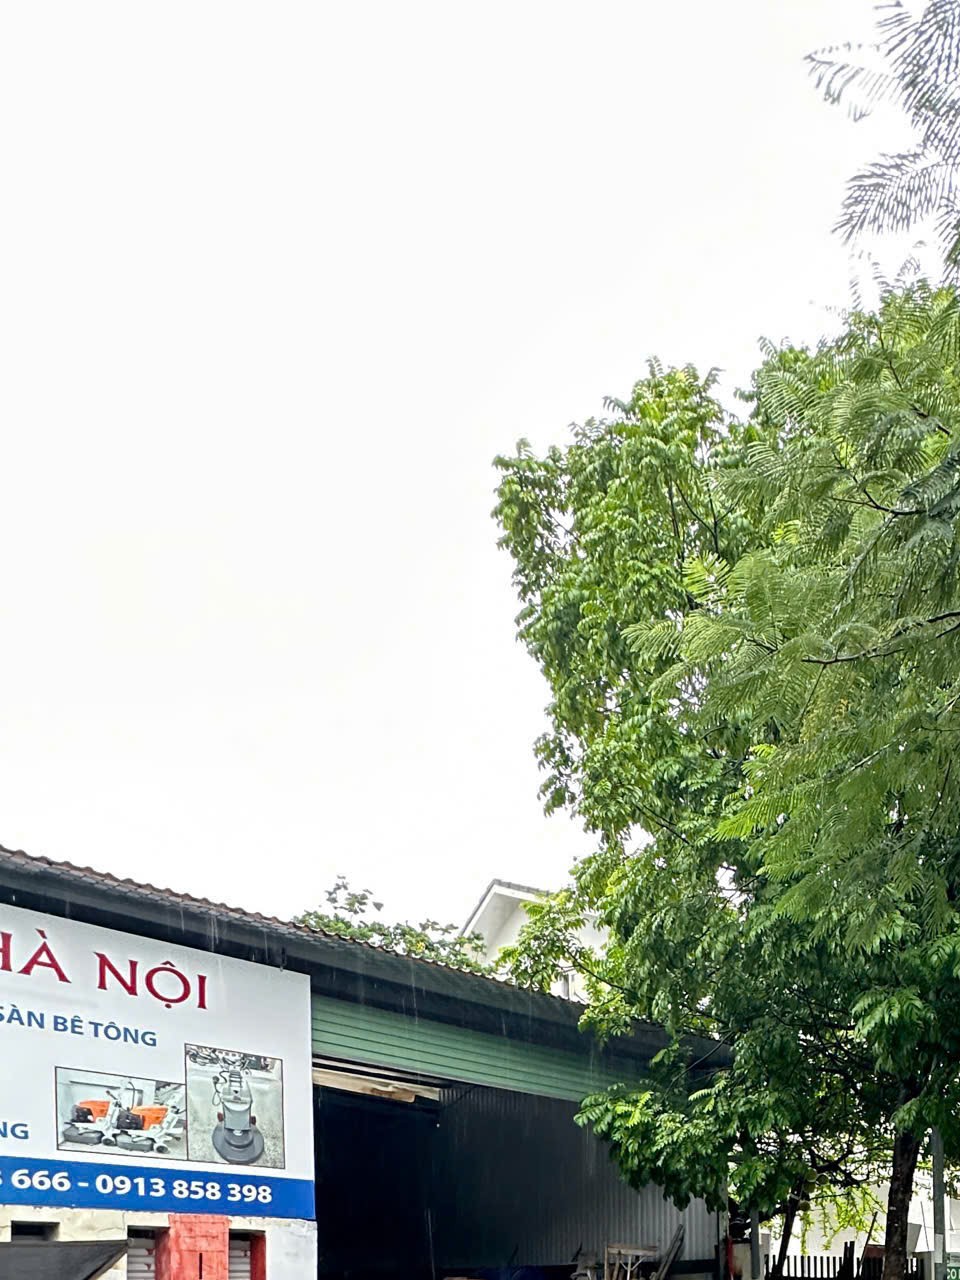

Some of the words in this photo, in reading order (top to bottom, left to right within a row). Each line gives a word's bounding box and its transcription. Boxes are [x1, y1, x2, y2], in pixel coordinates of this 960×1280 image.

[92, 951, 208, 1010] NỘI
[53, 1015, 84, 1036] BÊ
[88, 1020, 157, 1047] TÔNG
[11, 1168, 72, 1192] 666
[95, 1174, 166, 1197] 0913
[172, 1179, 221, 1201] 858
[227, 1182, 273, 1204] 398
